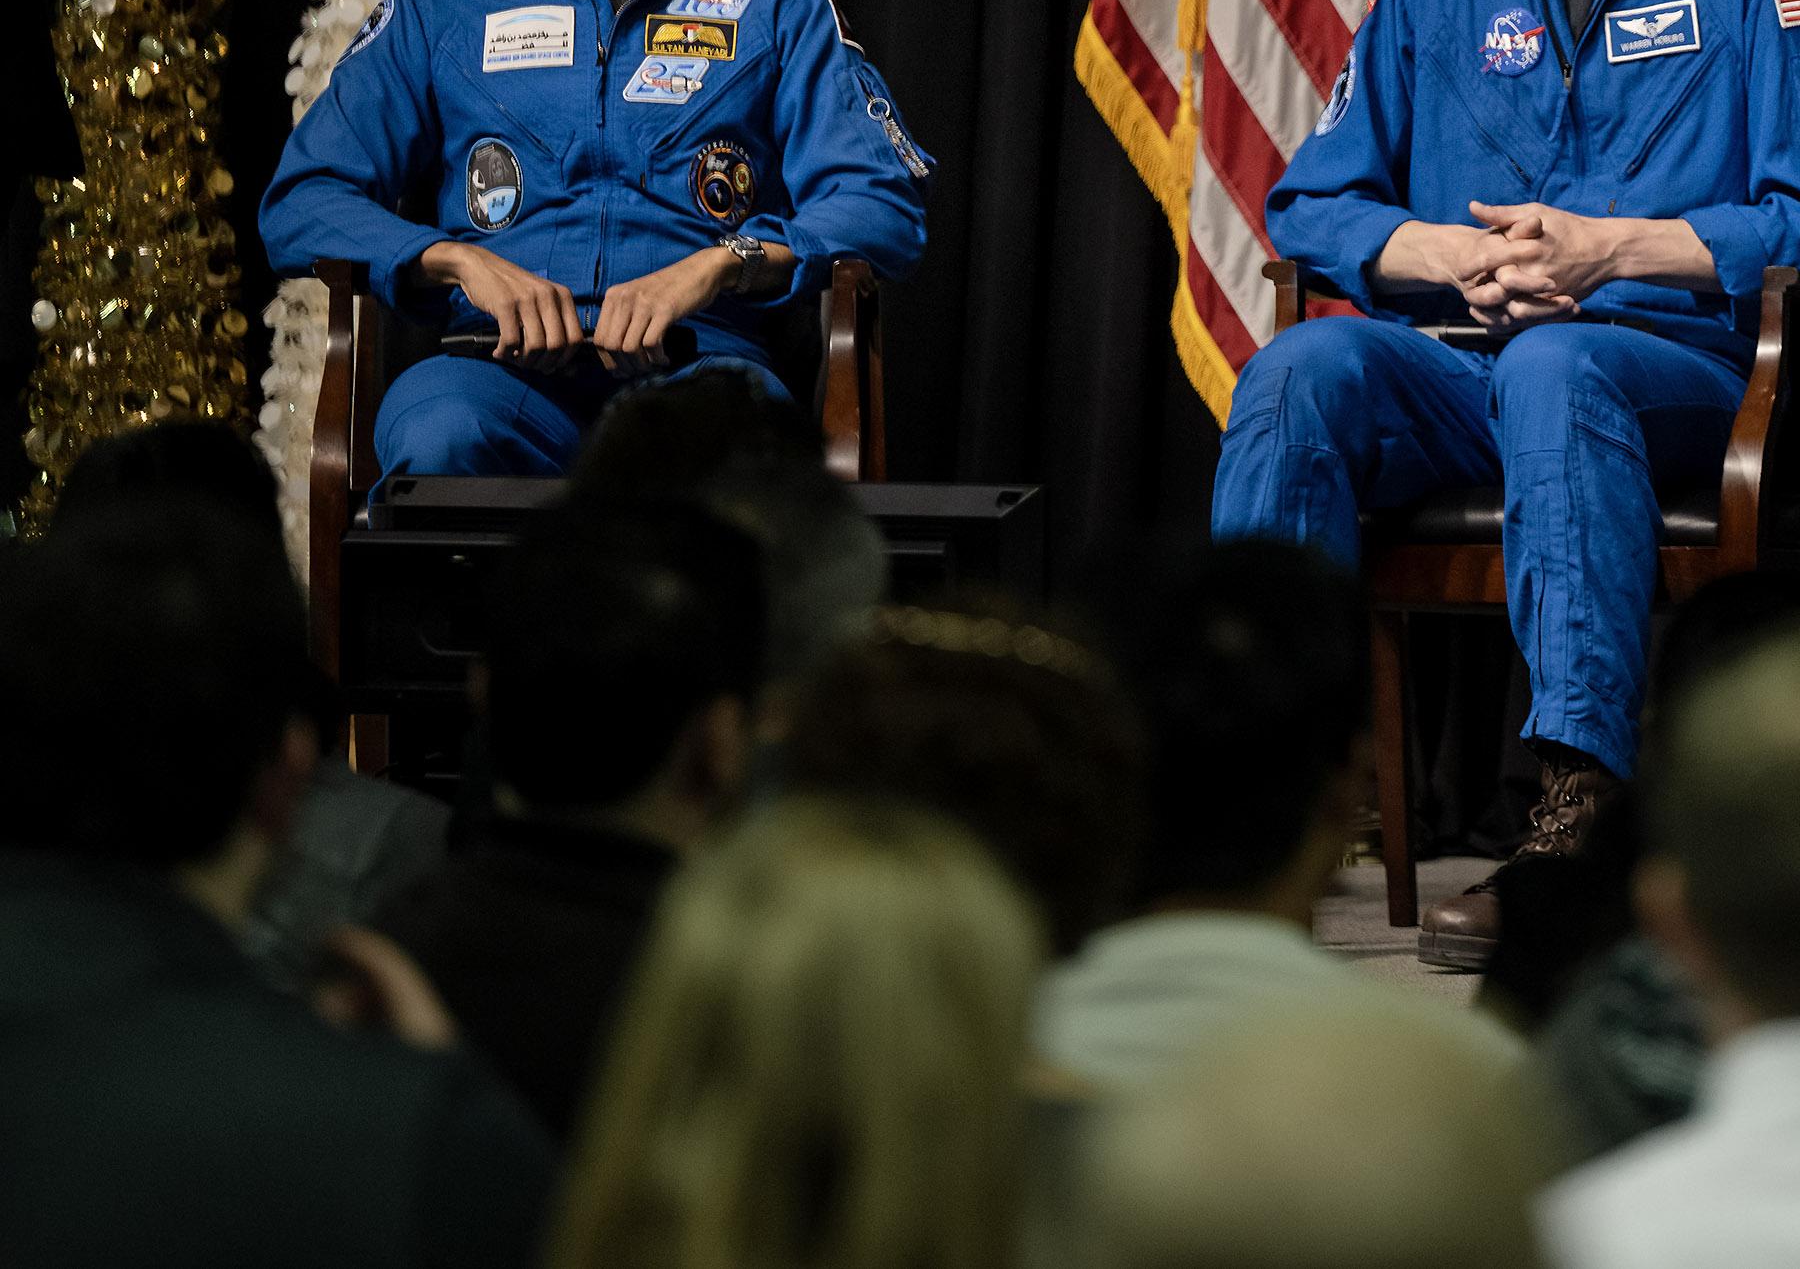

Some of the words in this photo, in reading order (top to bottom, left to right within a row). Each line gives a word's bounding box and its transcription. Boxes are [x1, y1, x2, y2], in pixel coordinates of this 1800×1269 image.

[652, 43, 685, 54] SULTAN
[687, 45, 729, 58] ALNEYADI
[1485, 31, 1540, 53] NASA
